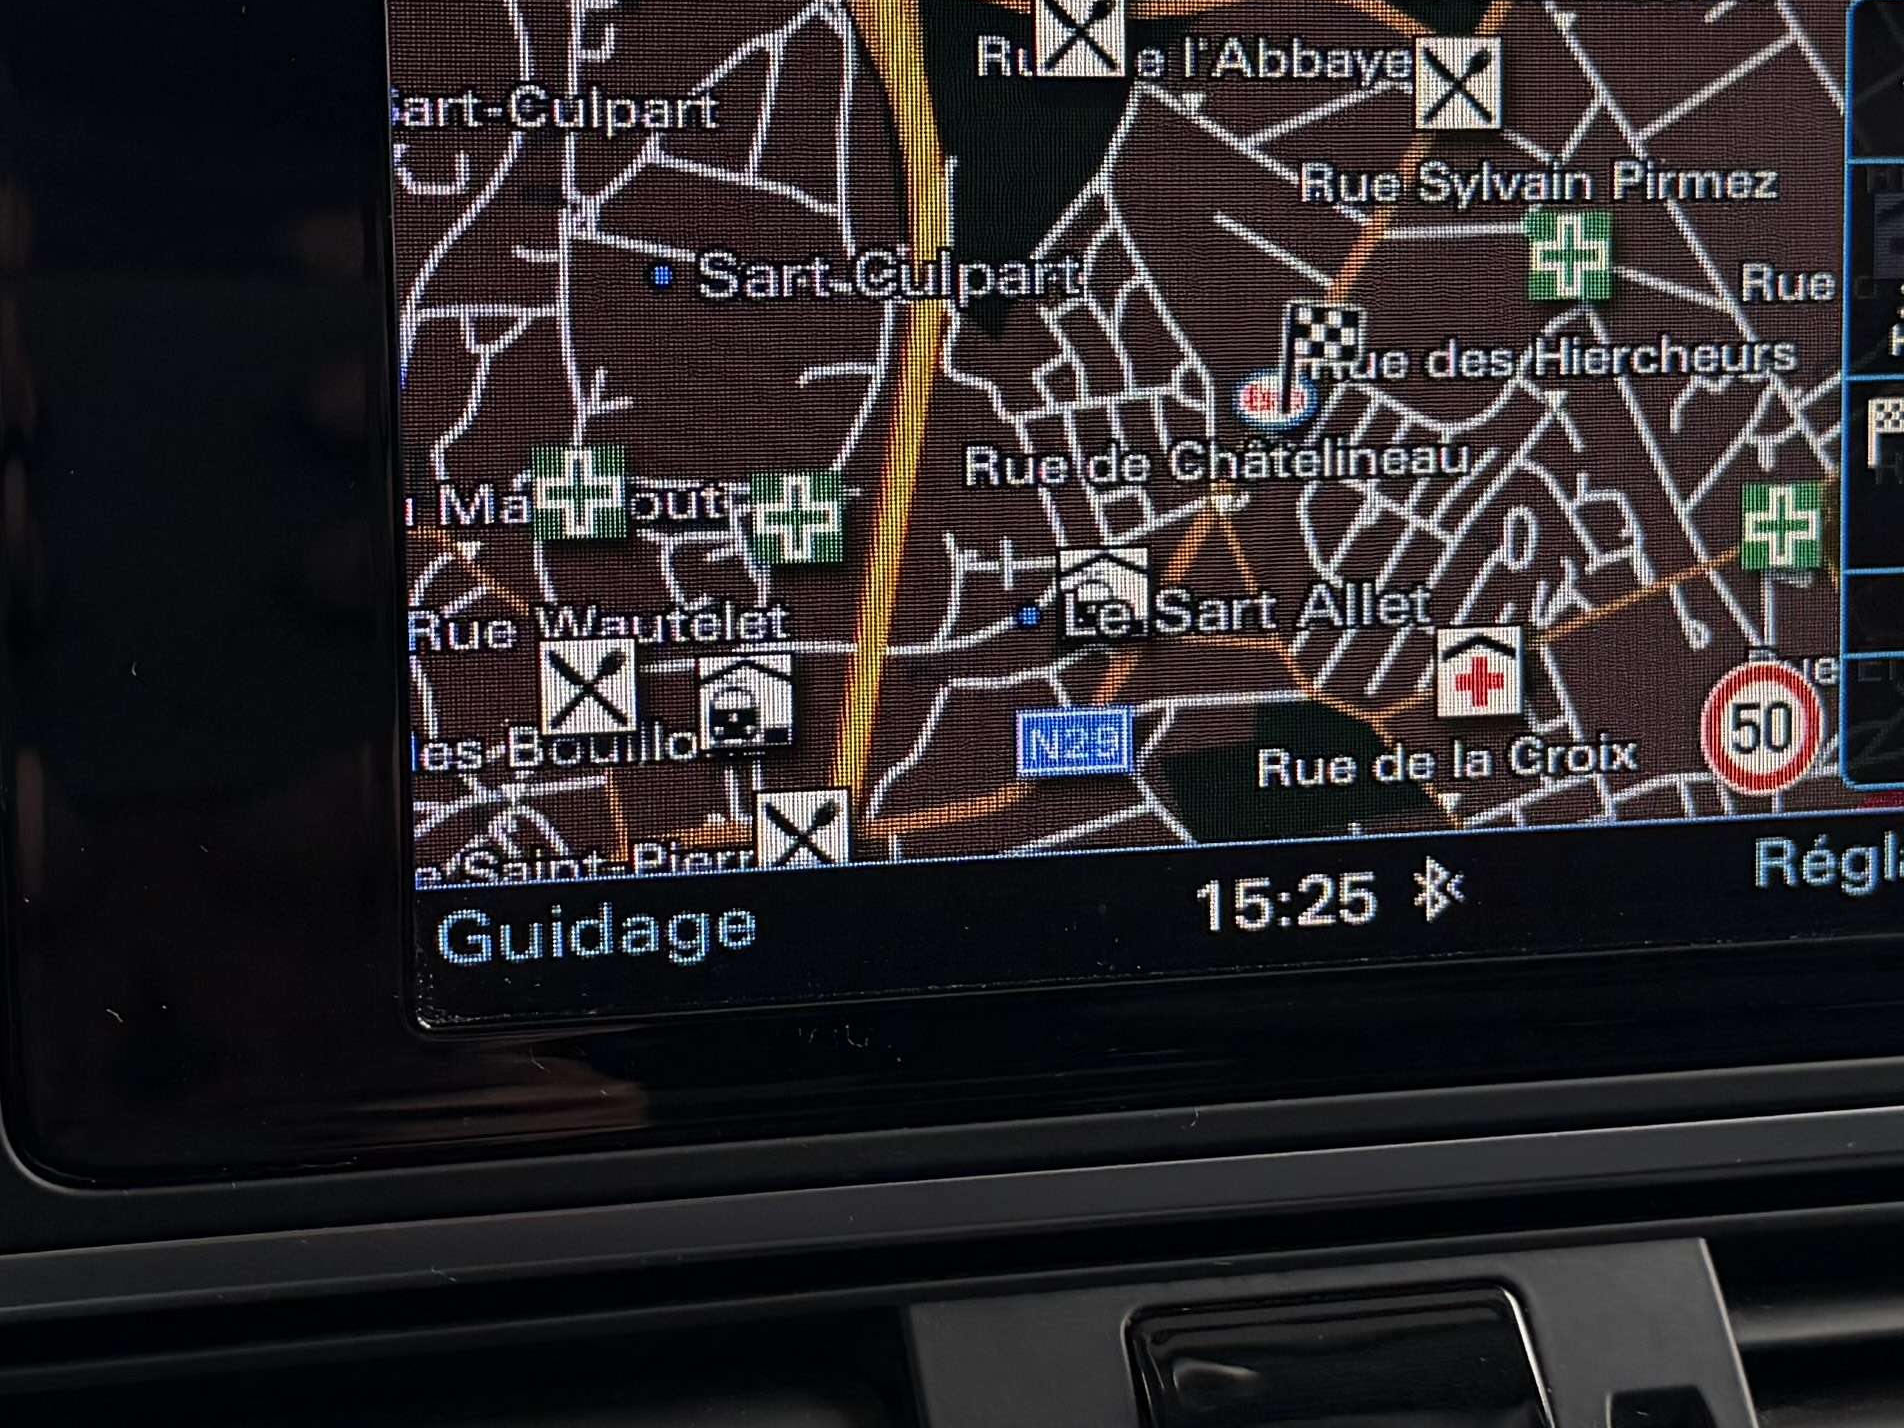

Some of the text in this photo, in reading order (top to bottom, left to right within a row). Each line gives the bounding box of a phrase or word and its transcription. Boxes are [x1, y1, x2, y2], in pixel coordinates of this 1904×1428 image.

[1184, 32, 1412, 89] l'Abbaye
[1300, 160, 1781, 210] Rue Sylvain Pirmez
[698, 247, 1083, 301] Sart-Culpart
[1742, 263, 1838, 303] Rue
[1426, 339, 1514, 380] des
[1532, 330, 1799, 376] Hiercheurs
[966, 434, 1470, 486] Rue de Châtelineau
[409, 603, 790, 652] Rue Wautelet
[1064, 582, 1432, 637] Le Sart Allet
[1028, 724, 1120, 762] N29
[1731, 702, 1793, 755] 50
[1257, 732, 1638, 788] Rue de la Croix
[458, 843, 756, 881] Saint-Pierr
[1197, 872, 1377, 932] 15:25
[437, 901, 757, 966] Guidage
